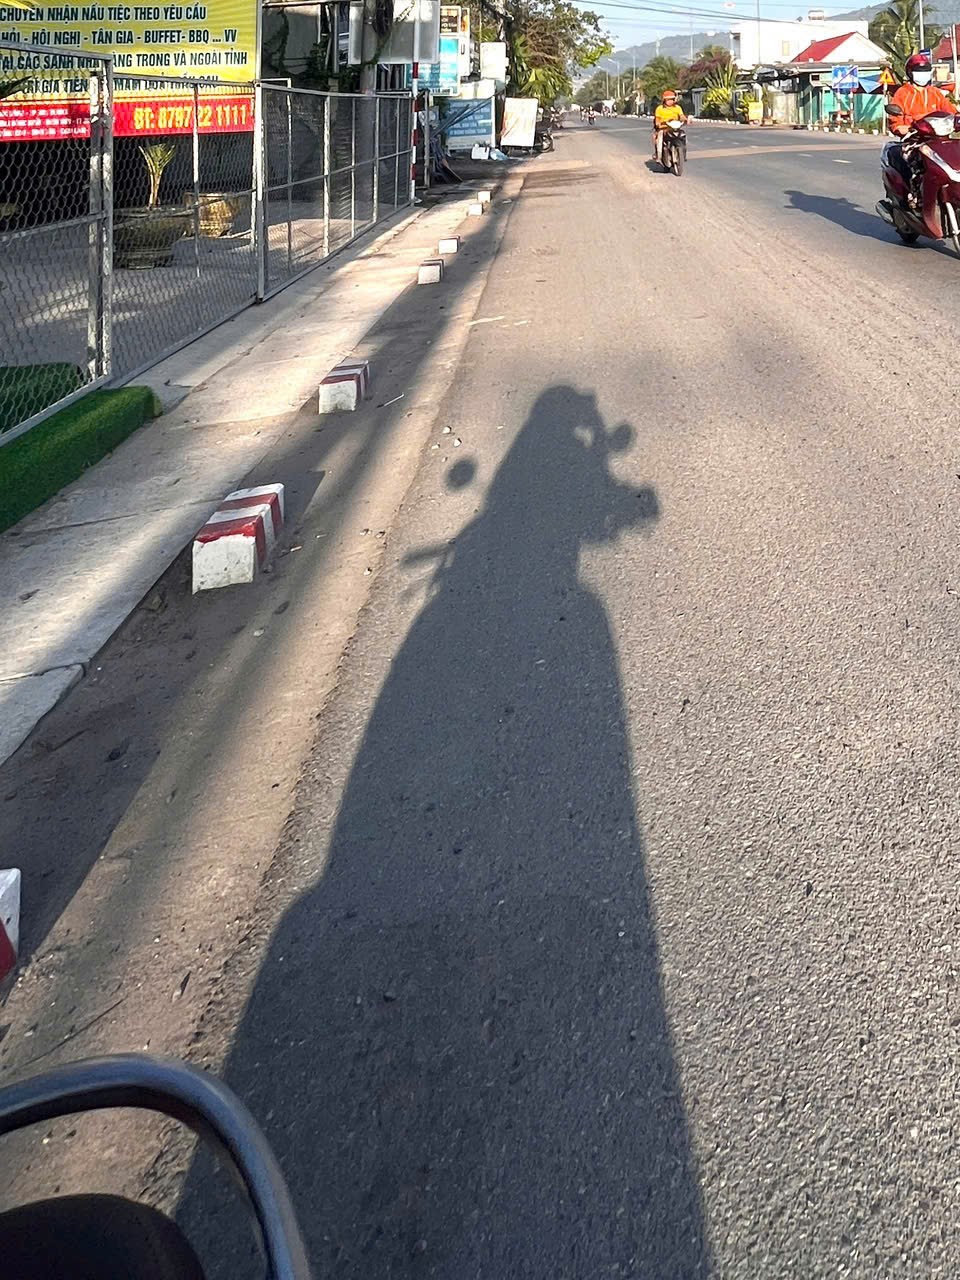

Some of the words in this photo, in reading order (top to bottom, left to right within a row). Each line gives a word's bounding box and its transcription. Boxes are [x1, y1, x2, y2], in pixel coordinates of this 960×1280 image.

[47, 4, 79, 24] NHẬN
[82, 2, 104, 21] NẤU
[108, 4, 131, 23] TIỆC
[134, 6, 160, 21] THEO
[163, 4, 183, 20] YÊU
[54, 31, 81, 48] NGHỊ
[92, 28, 113, 45] TÂN
[116, 30, 134, 44] GIA
[188, 29, 209, 44] BBQ
[224, 29, 237, 42] VV
[136, 53, 170, 66] TRONG
[174, 50, 187, 66] VÀ
[190, 50, 221, 65] NGOÀI
[224, 48, 247, 65] TỈNH
[216, 104, 246, 126] 1111
